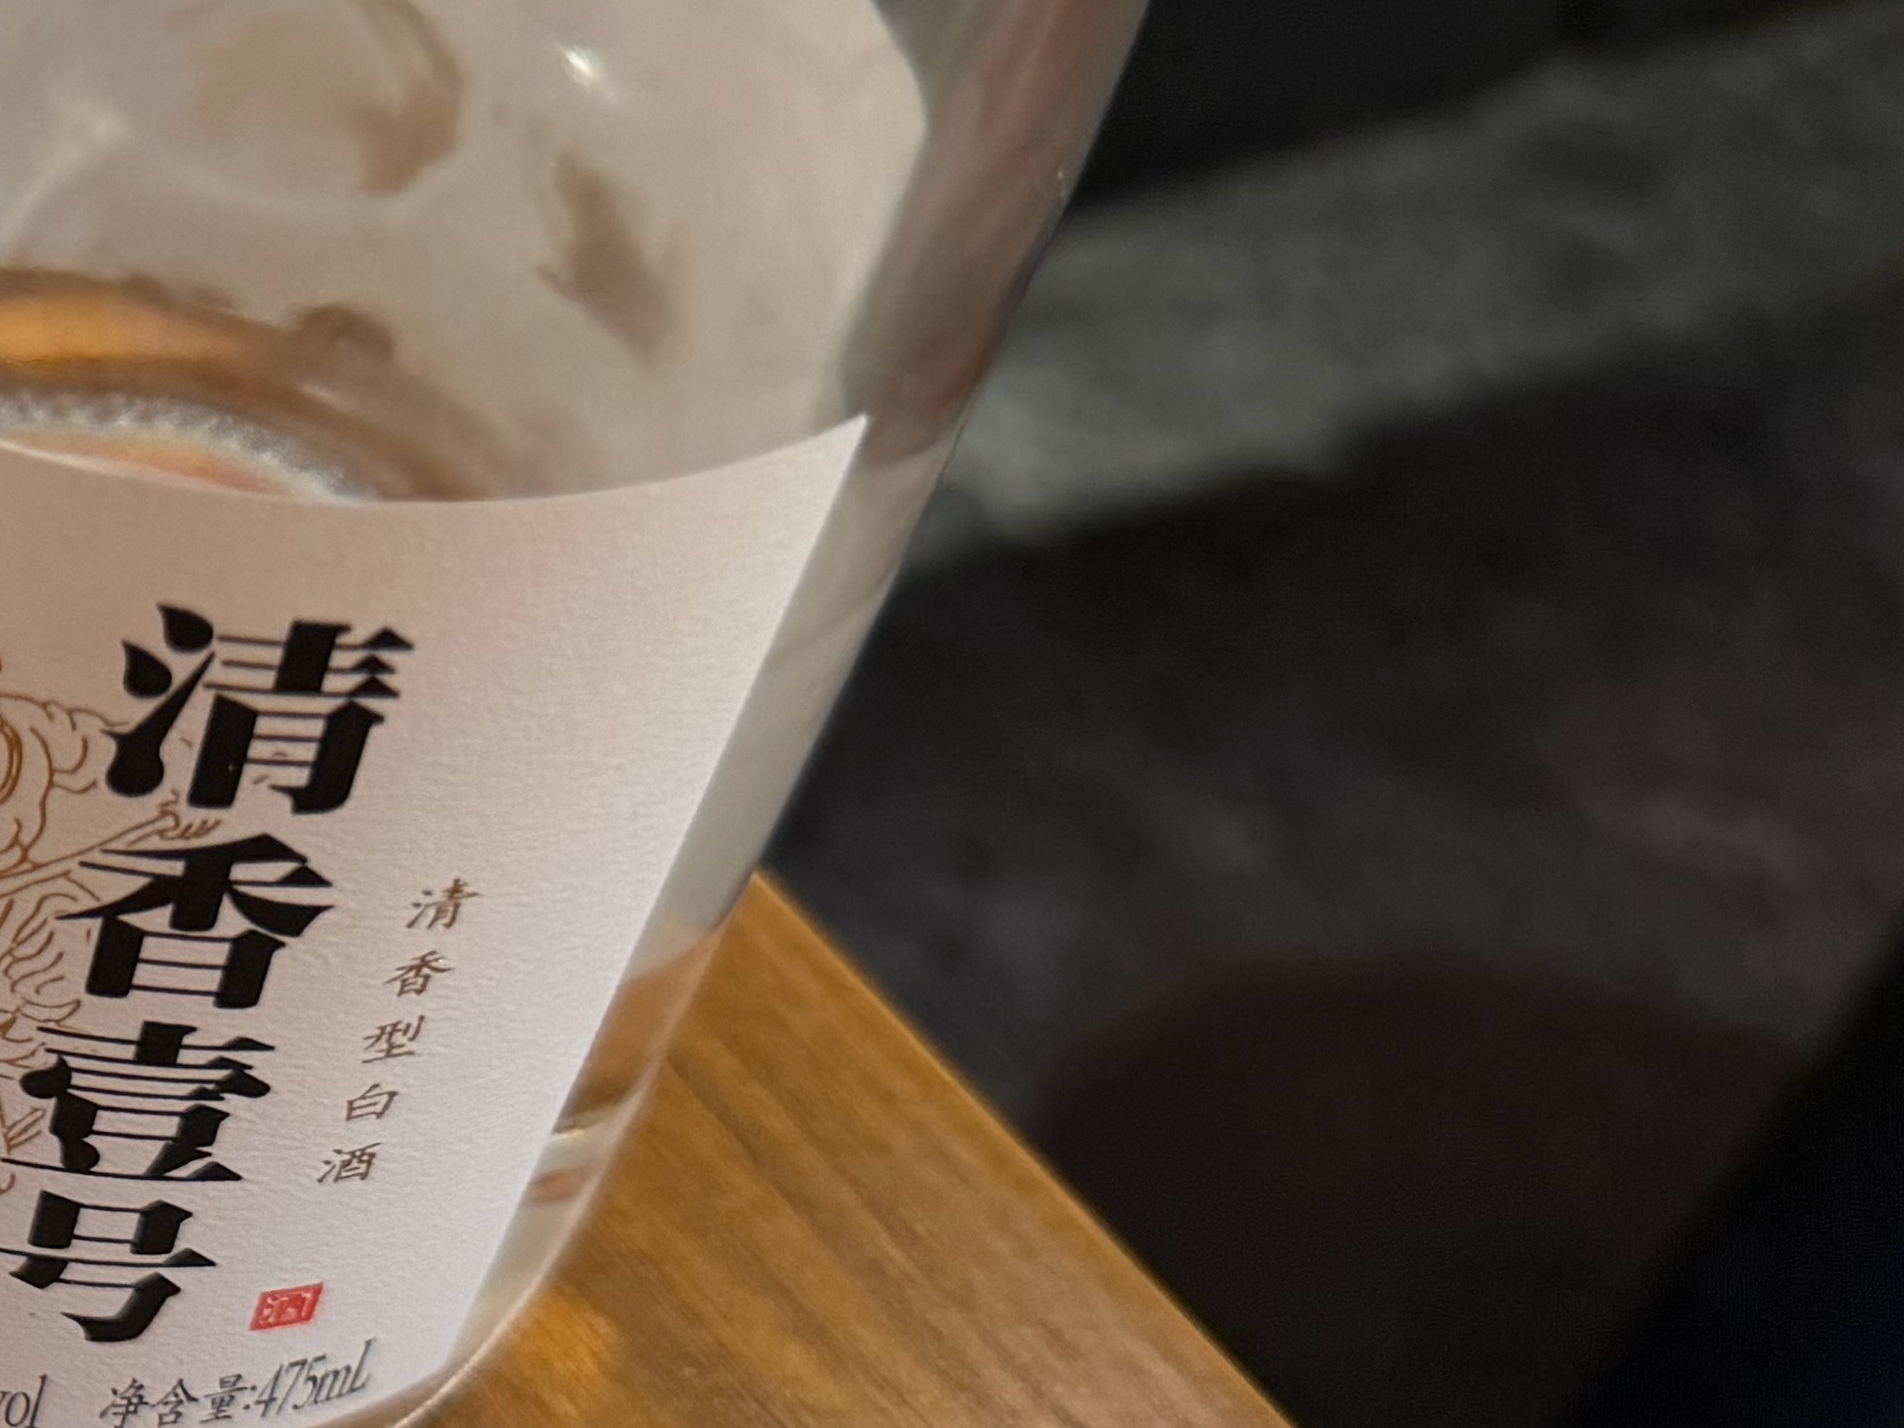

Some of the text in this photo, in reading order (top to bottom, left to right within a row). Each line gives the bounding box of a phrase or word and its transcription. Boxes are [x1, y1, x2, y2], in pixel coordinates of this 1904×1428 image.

[316, 877, 481, 1184] 清香型白酒
